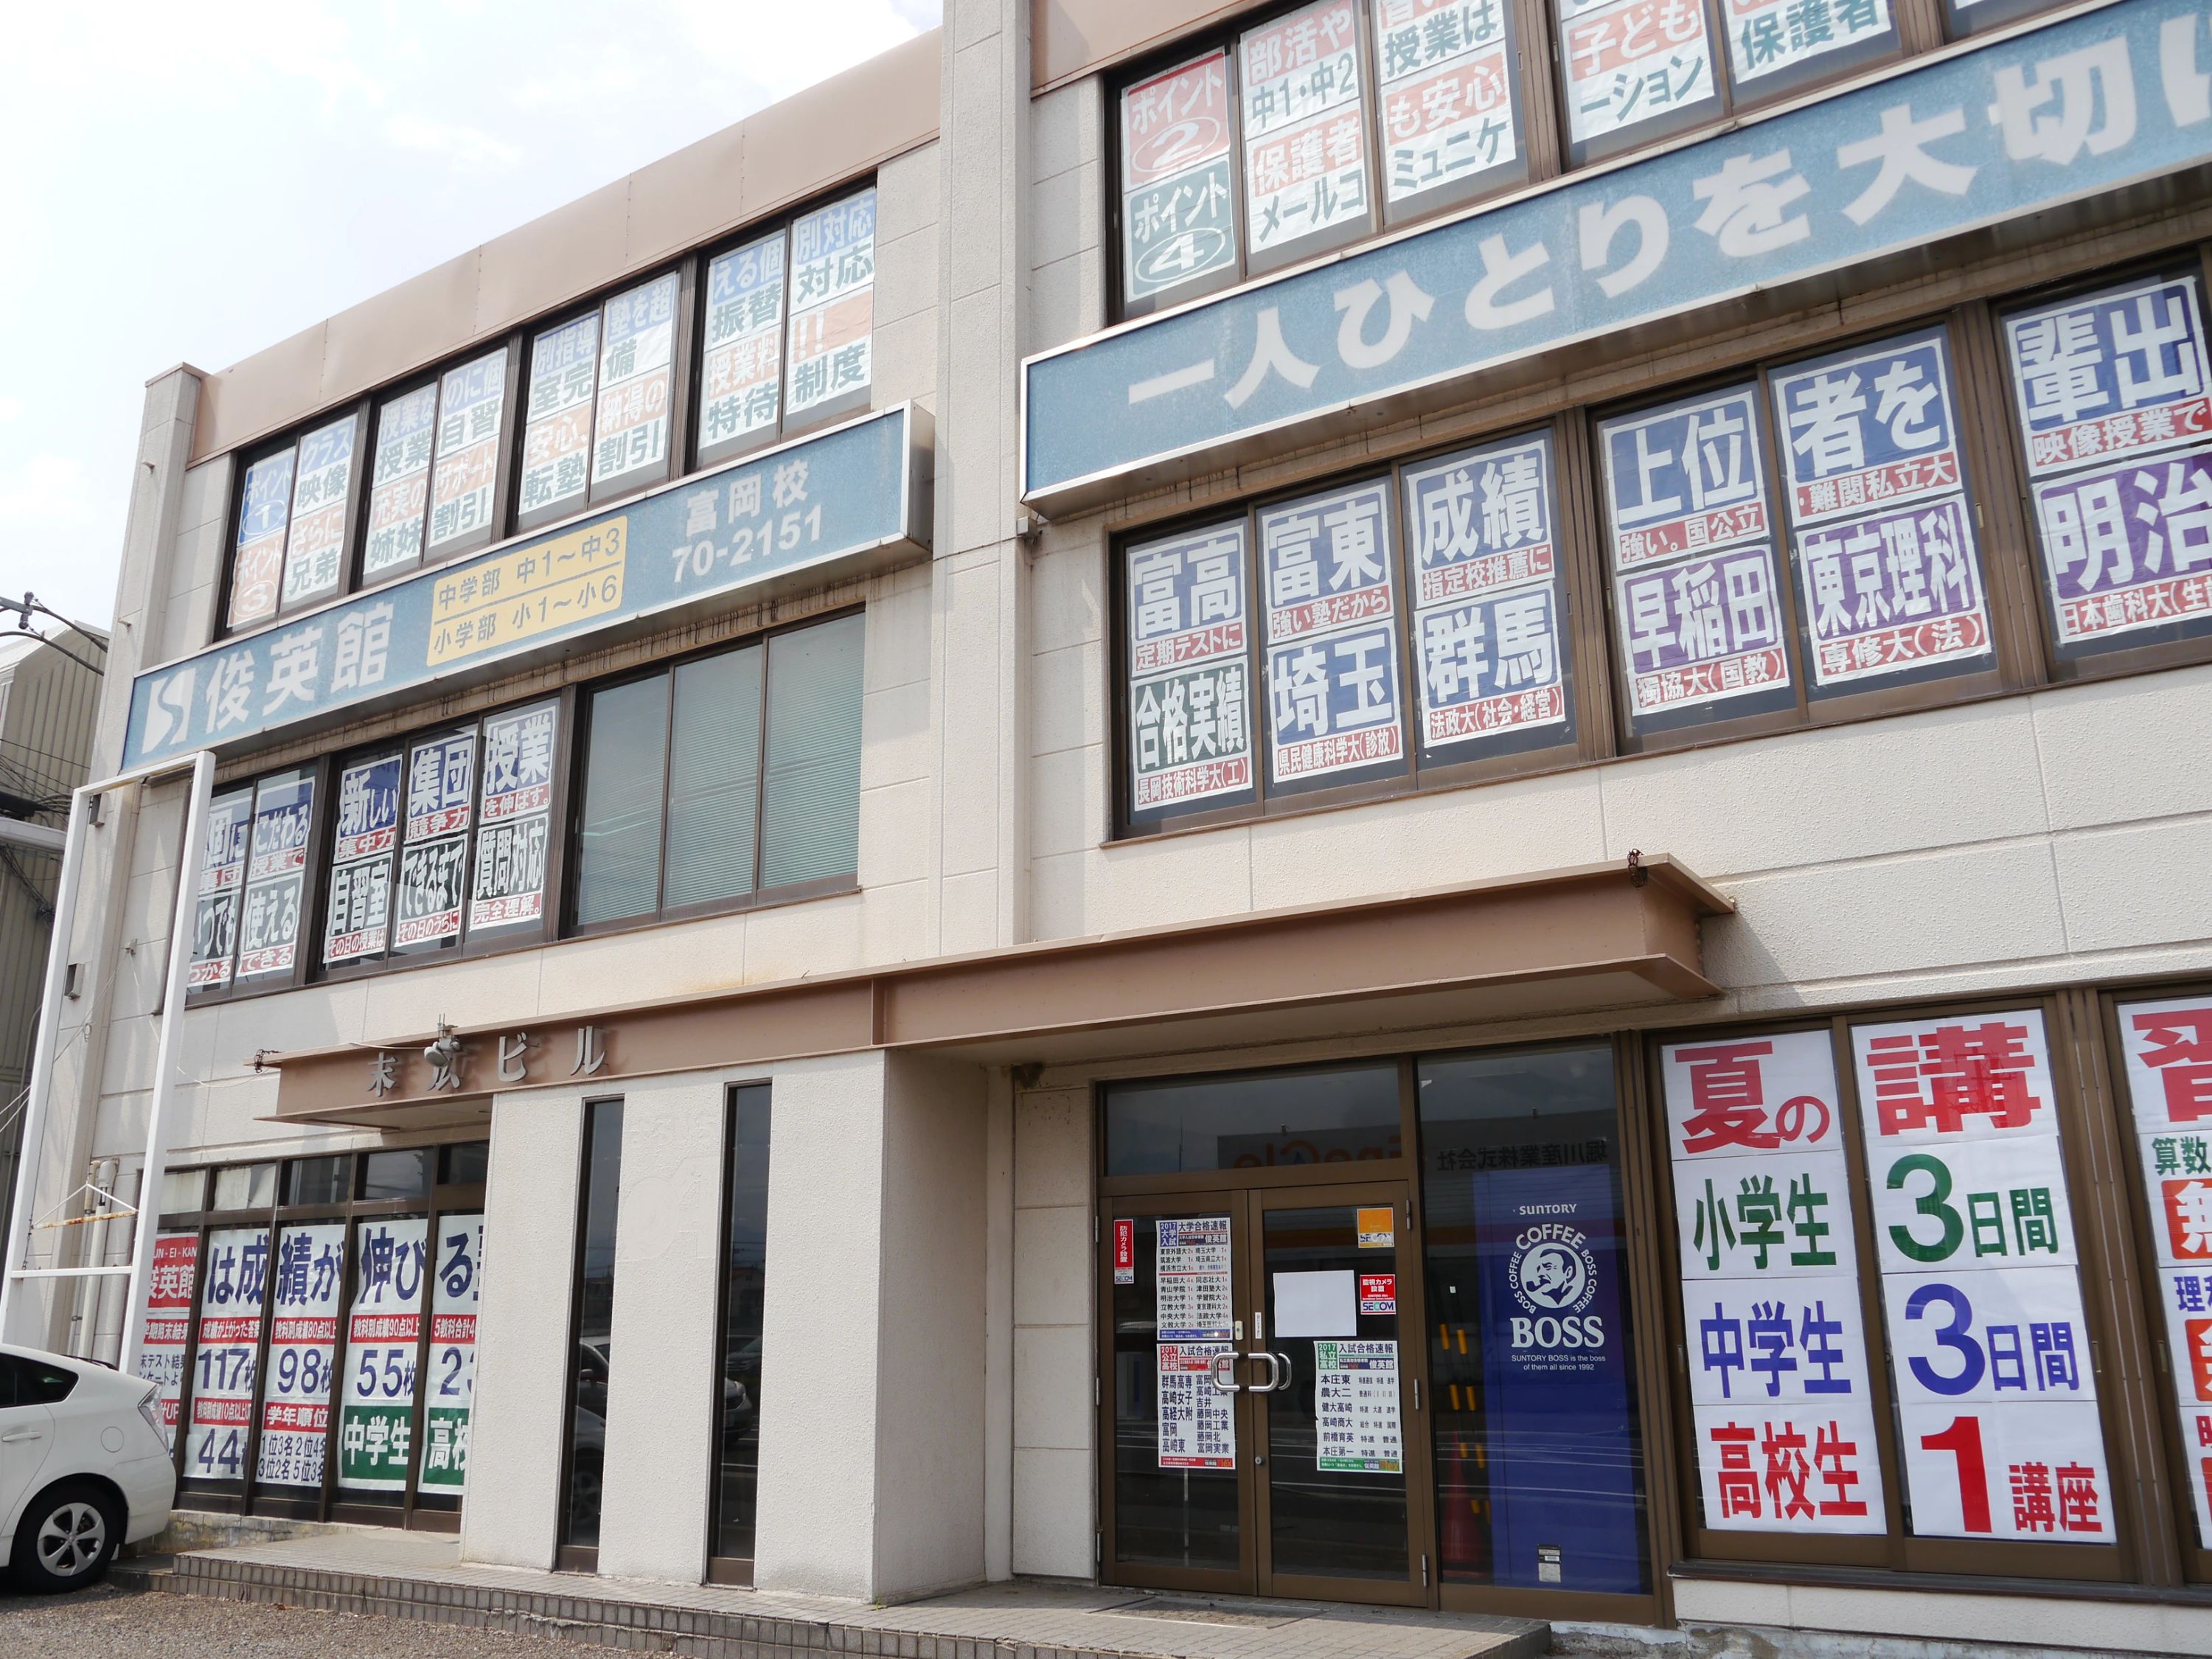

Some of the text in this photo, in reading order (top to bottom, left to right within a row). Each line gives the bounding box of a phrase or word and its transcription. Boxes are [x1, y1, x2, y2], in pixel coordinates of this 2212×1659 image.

[1248, 4, 1352, 80] 部活や
[1385, 5, 1498, 77] 授業は
[1572, 0, 1700, 77] 子ども
[1131, 63, 1223, 135] ポイント
[1388, 66, 1505, 137] も安心
[1256, 115, 1362, 193] 保護者
[1394, 118, 1509, 189] ミュニケ
[797, 201, 872, 262] 別対応
[1134, 171, 1228, 243] ポイント
[1259, 170, 1365, 243] メールコ
[716, 243, 782, 299] える個
[798, 245, 874, 304] 対応
[712, 283, 782, 342] 振替
[537, 318, 597, 373] 別指導
[608, 339, 636, 382] 備
[709, 333, 779, 394] 授業料
[795, 344, 866, 403] 制度
[2017, 294, 2199, 422] 輩出
[535, 362, 594, 413] 室完
[602, 380, 664, 432] 納得の
[709, 383, 779, 439] 特待
[442, 398, 499, 451] 自習
[1790, 361, 1941, 477] 者を
[2034, 400, 2208, 465] 映像授業で
[304, 428, 350, 473] クラス
[379, 429, 432, 481] 授業
[437, 451, 493, 496] サポート
[599, 420, 659, 476] 割引
[1618, 408, 1755, 525] 上位
[247, 459, 291, 501] ポイント
[299, 464, 347, 507] 映像
[374, 479, 426, 525] 充実の
[524, 453, 585, 507] 転塾
[686, 461, 810, 537] 富岡校
[292, 512, 344, 554] さらに
[434, 487, 487, 538] 割引
[1422, 454, 1546, 565] 成績
[1621, 504, 1762, 563] 強い。国公立
[2042, 463, 2212, 592] 明治
[237, 544, 282, 585] ポイント
[371, 518, 421, 567] 姉妹
[673, 505, 822, 583] 70-2151
[1268, 499, 1382, 606] 富東
[1806, 505, 1971, 636] 東京理科
[289, 548, 338, 596] 兄弟
[438, 567, 501, 611] 中学部
[1135, 540, 1238, 639] 富高
[1424, 547, 1549, 599] 指定校推薦に
[434, 613, 497, 655] 小学部
[1273, 589, 1388, 639] 強い塾だから
[1631, 557, 1776, 667] 早稲田
[206, 602, 394, 734] 俊英館
[1137, 625, 1242, 670] 定期テストに
[1425, 594, 1553, 703] 群馬
[1823, 616, 1980, 673] 専修大(法)
[1274, 633, 1392, 737] 埼玉
[1137, 667, 1244, 770] 合格実績
[411, 742, 471, 814] 集団
[487, 714, 552, 793] 授業
[254, 804, 308, 852] こだわる
[342, 770, 397, 835] 新しい
[410, 809, 468, 839] 競争力
[486, 788, 549, 816] を伸ばす。
[251, 849, 305, 876] 授業で
[340, 828, 395, 858] 集中力
[479, 817, 544, 898] 質問対応
[332, 862, 390, 935] 自習室
[405, 843, 463, 914] できるまで
[246, 886, 296, 950] 使える
[398, 913, 459, 941] その日のうちに
[475, 894, 540, 922] 完全理解。
[246, 945, 293, 968] できる
[329, 928, 385, 957] その日の授業は
[1674, 1041, 1832, 1154] 夏の
[1866, 1021, 2042, 1136] 講
[1178, 1221, 1227, 1231] 大学合格速報
[1694, 1172, 1837, 1271] 小学生
[1888, 1153, 2059, 1263] 3日間
[1515, 1223, 1587, 1250] COFFEE
[208, 1234, 268, 1305] は成
[276, 1232, 344, 1306] 績が
[360, 1227, 427, 1304] 伸び
[1509, 1251, 1537, 1315] BOSS COFFEE
[1573, 1249, 1597, 1314] BOSS COFFEE
[275, 1319, 335, 1339] 教科別成績80点以上
[353, 1318, 419, 1337] 教科別成績90点以上
[1363, 1302, 1394, 1311] SECOM
[1510, 1315, 1605, 1349] BOSS
[1339, 1343, 1394, 1353] 入試合格速報
[1700, 1300, 1852, 1399] 中学生
[1905, 1283, 2080, 1396] 3日間
[1162, 1375, 1192, 1389] 群馬高専
[1162, 1391, 1192, 1405] 高崎女子
[1197, 1397, 1211, 1408] 吉井
[1321, 1374, 1351, 1384] 本庄東
[1321, 1388, 1352, 1397] 農大二
[267, 1406, 328, 1428] 学年順位
[1322, 1402, 1352, 1413] 健大高崎
[1322, 1417, 1352, 1427] 高崎商大
[344, 1416, 411, 1466] 中学生
[1162, 1439, 1185, 1453] 高崎東
[1323, 1433, 1354, 1443] 前橋育英
[1323, 1447, 1354, 1456] 本庄第一
[1711, 1420, 1868, 1522] 高校生
